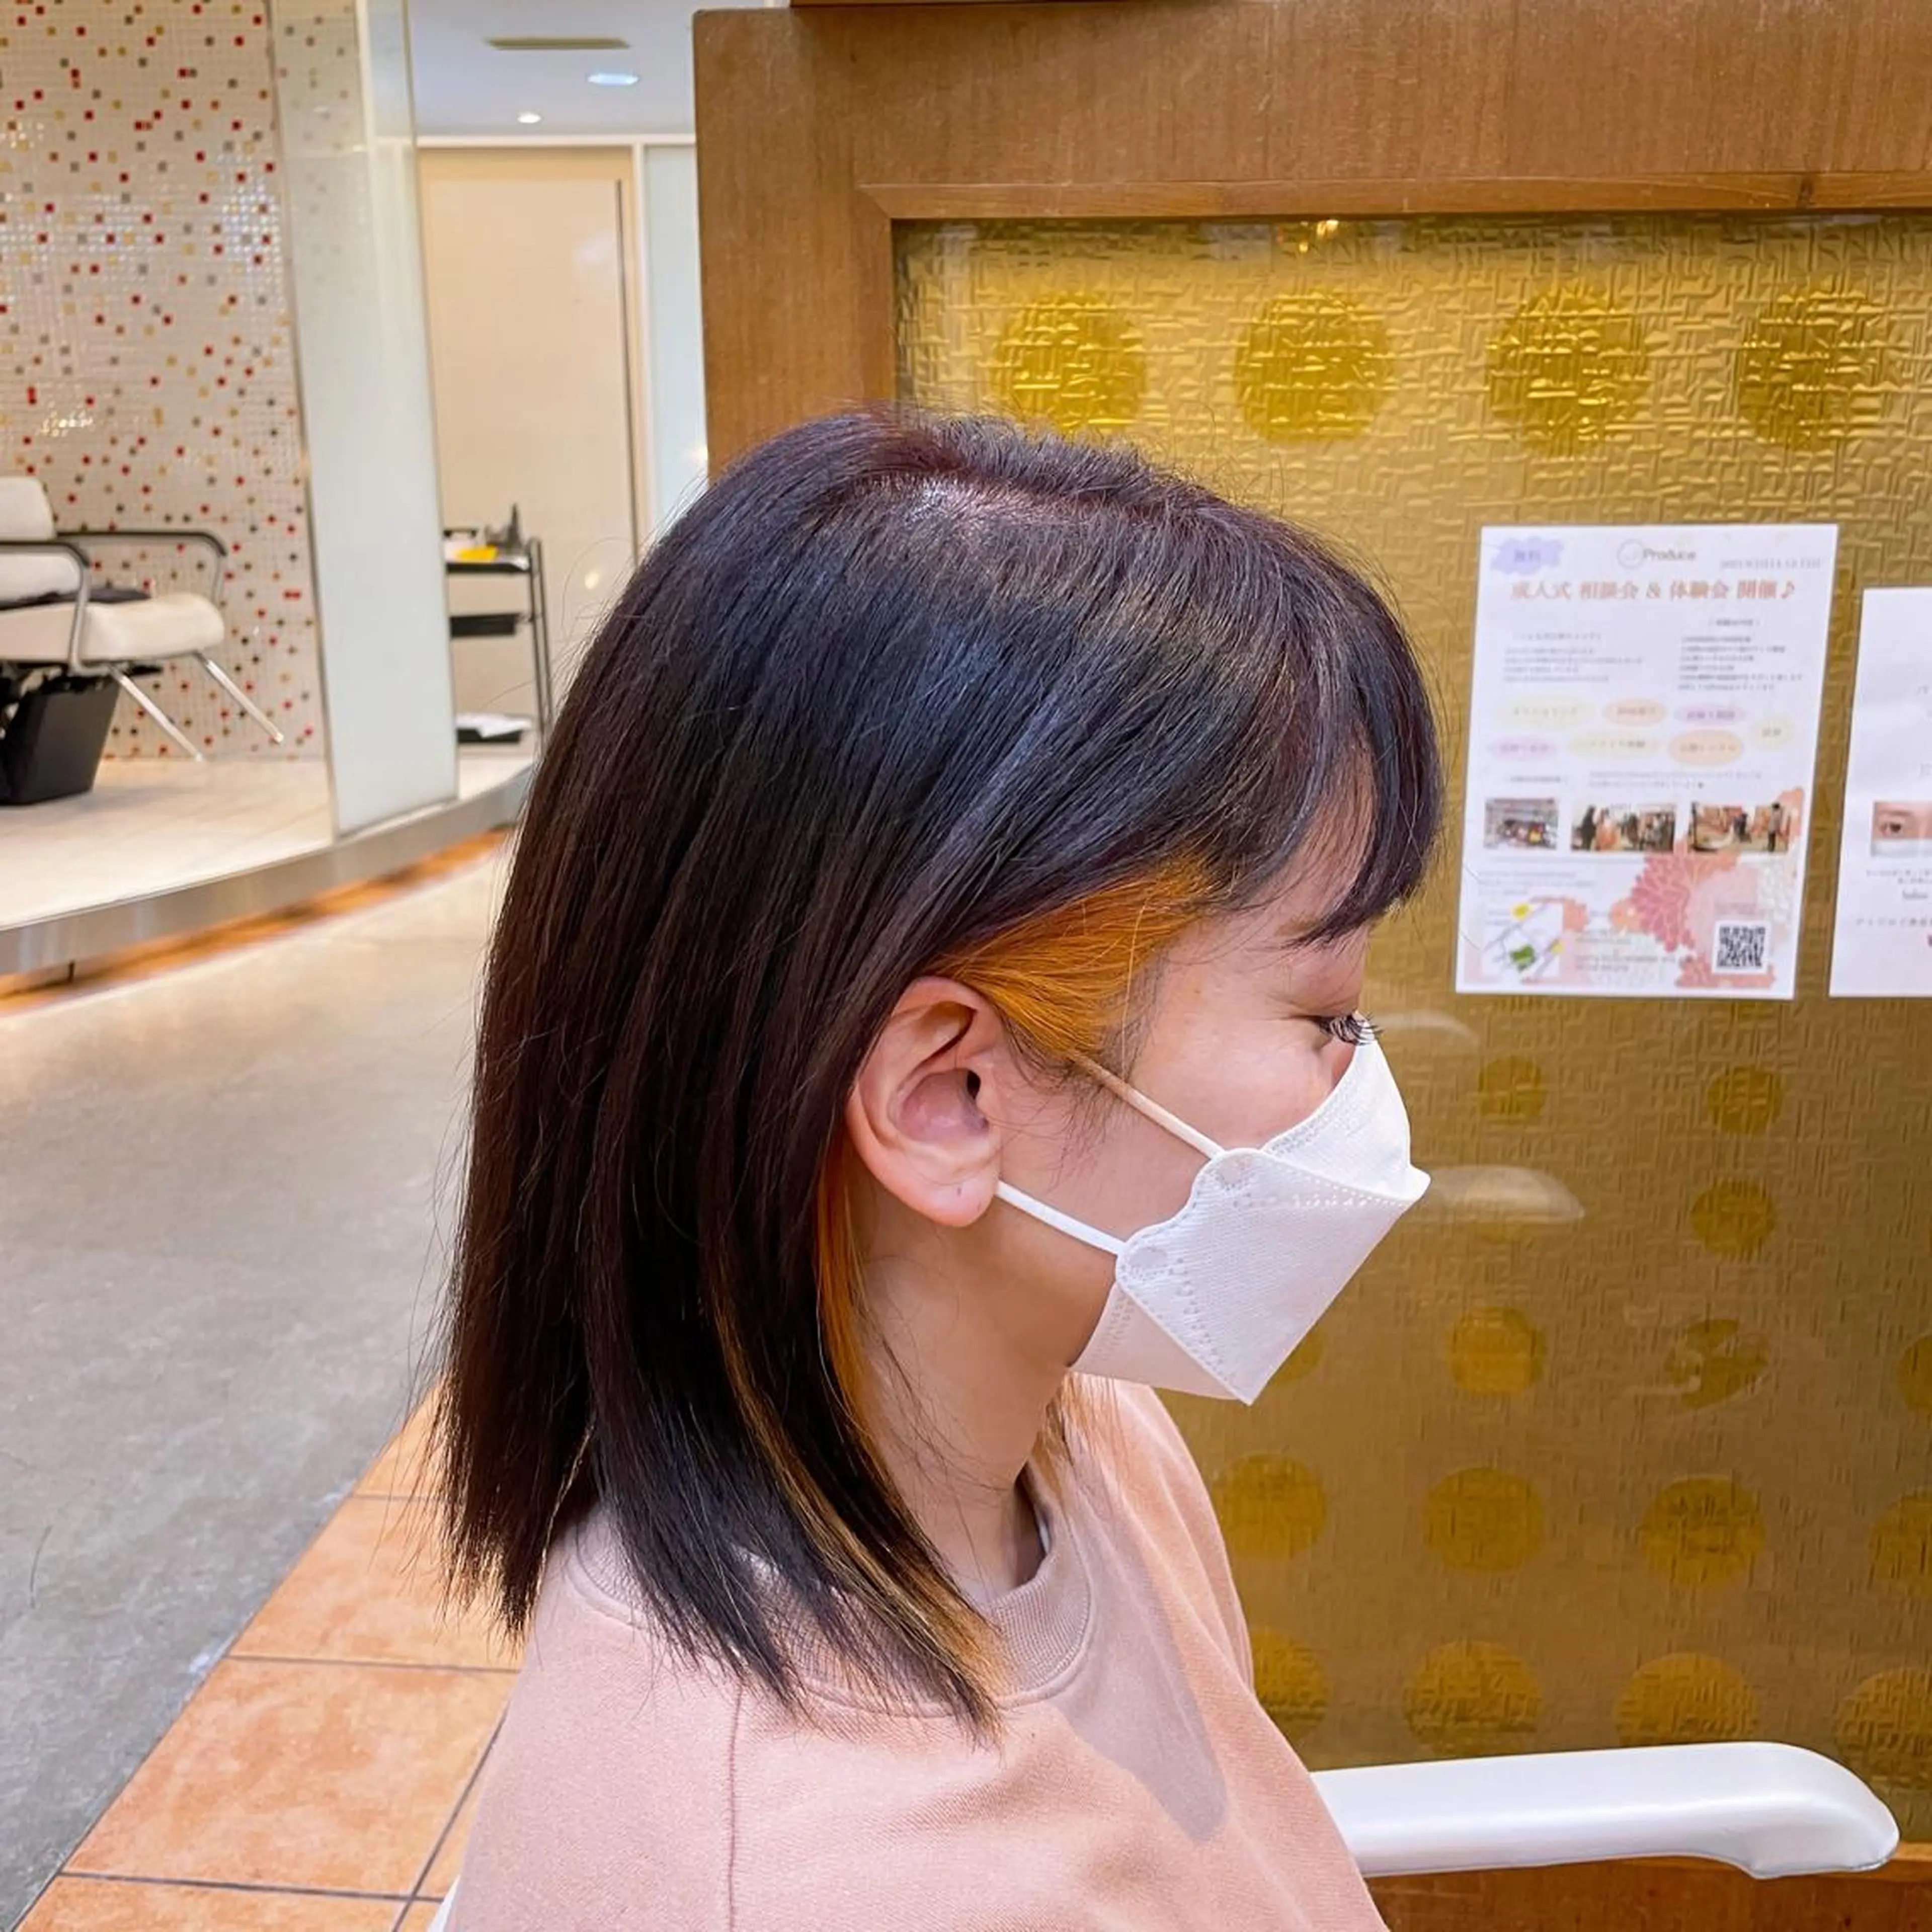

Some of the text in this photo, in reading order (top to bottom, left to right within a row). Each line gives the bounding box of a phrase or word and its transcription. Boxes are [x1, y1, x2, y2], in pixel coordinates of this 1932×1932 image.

[1644, 547, 1696, 562] Produce
[1511, 580, 1572, 600] 成人式
